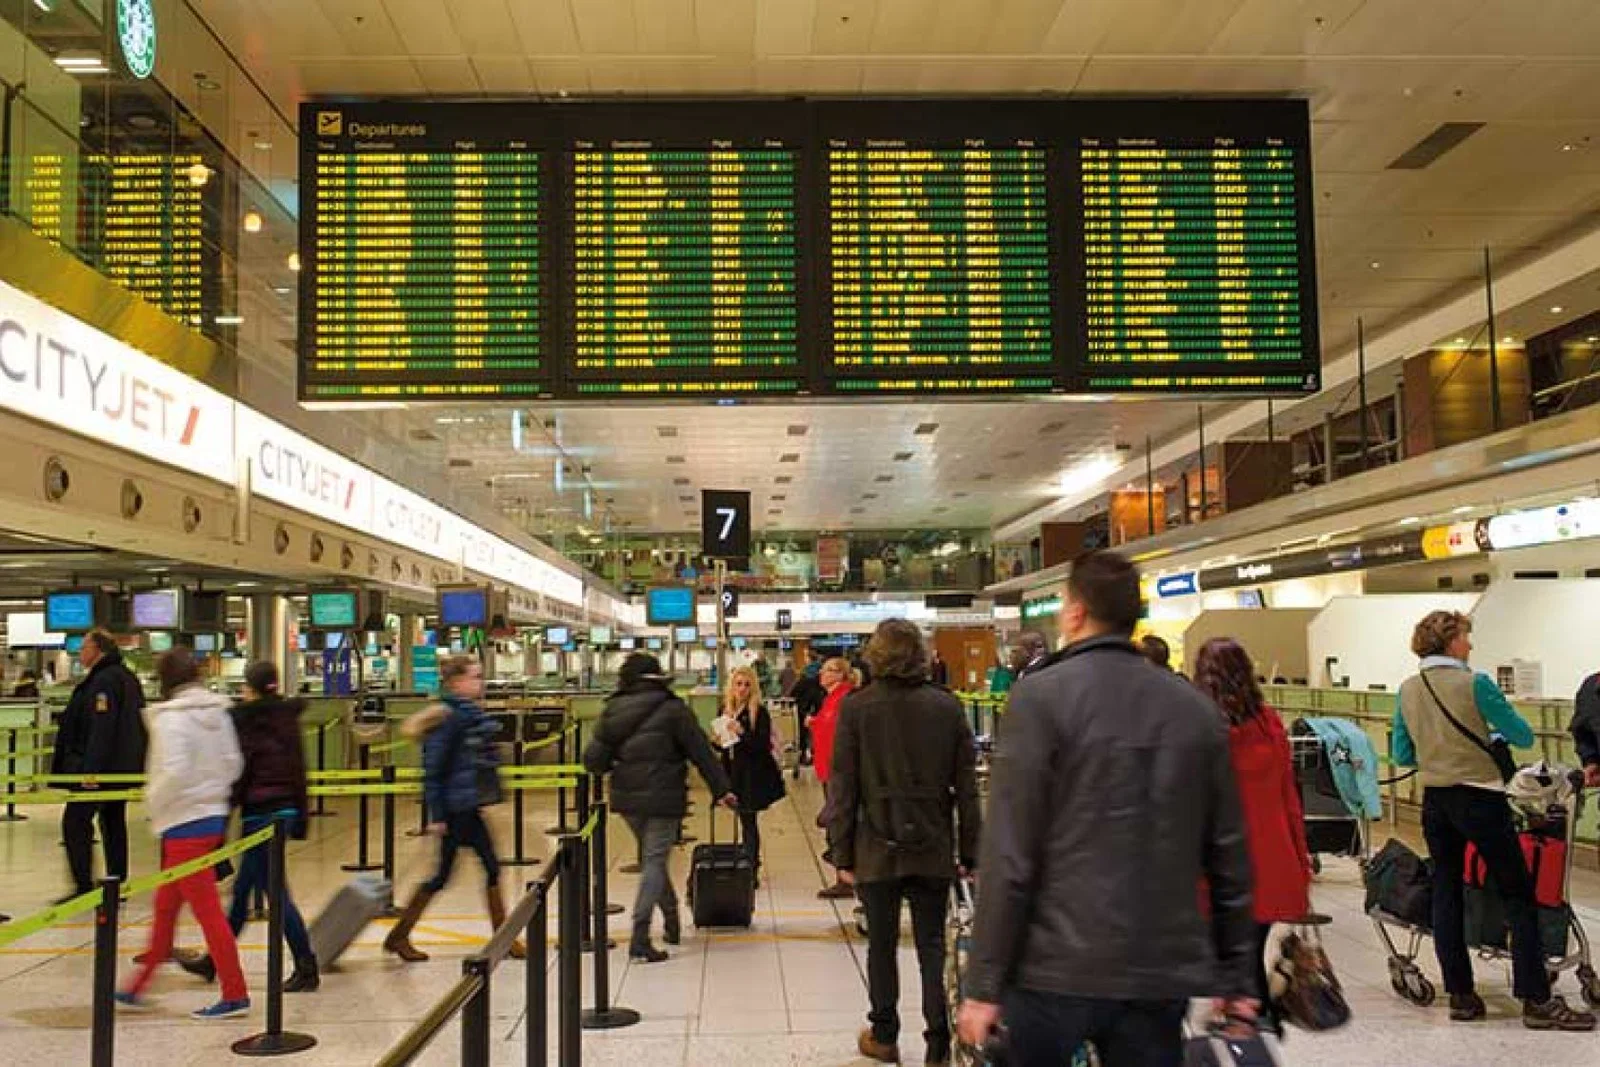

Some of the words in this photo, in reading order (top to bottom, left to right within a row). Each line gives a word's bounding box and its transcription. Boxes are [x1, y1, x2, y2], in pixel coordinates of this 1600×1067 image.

[347, 121, 426, 138] Departures
[0, 318, 175, 441] CITYJET
[259, 439, 341, 508] CITYJET
[715, 508, 736, 541] 7
[721, 591, 732, 609] 9
